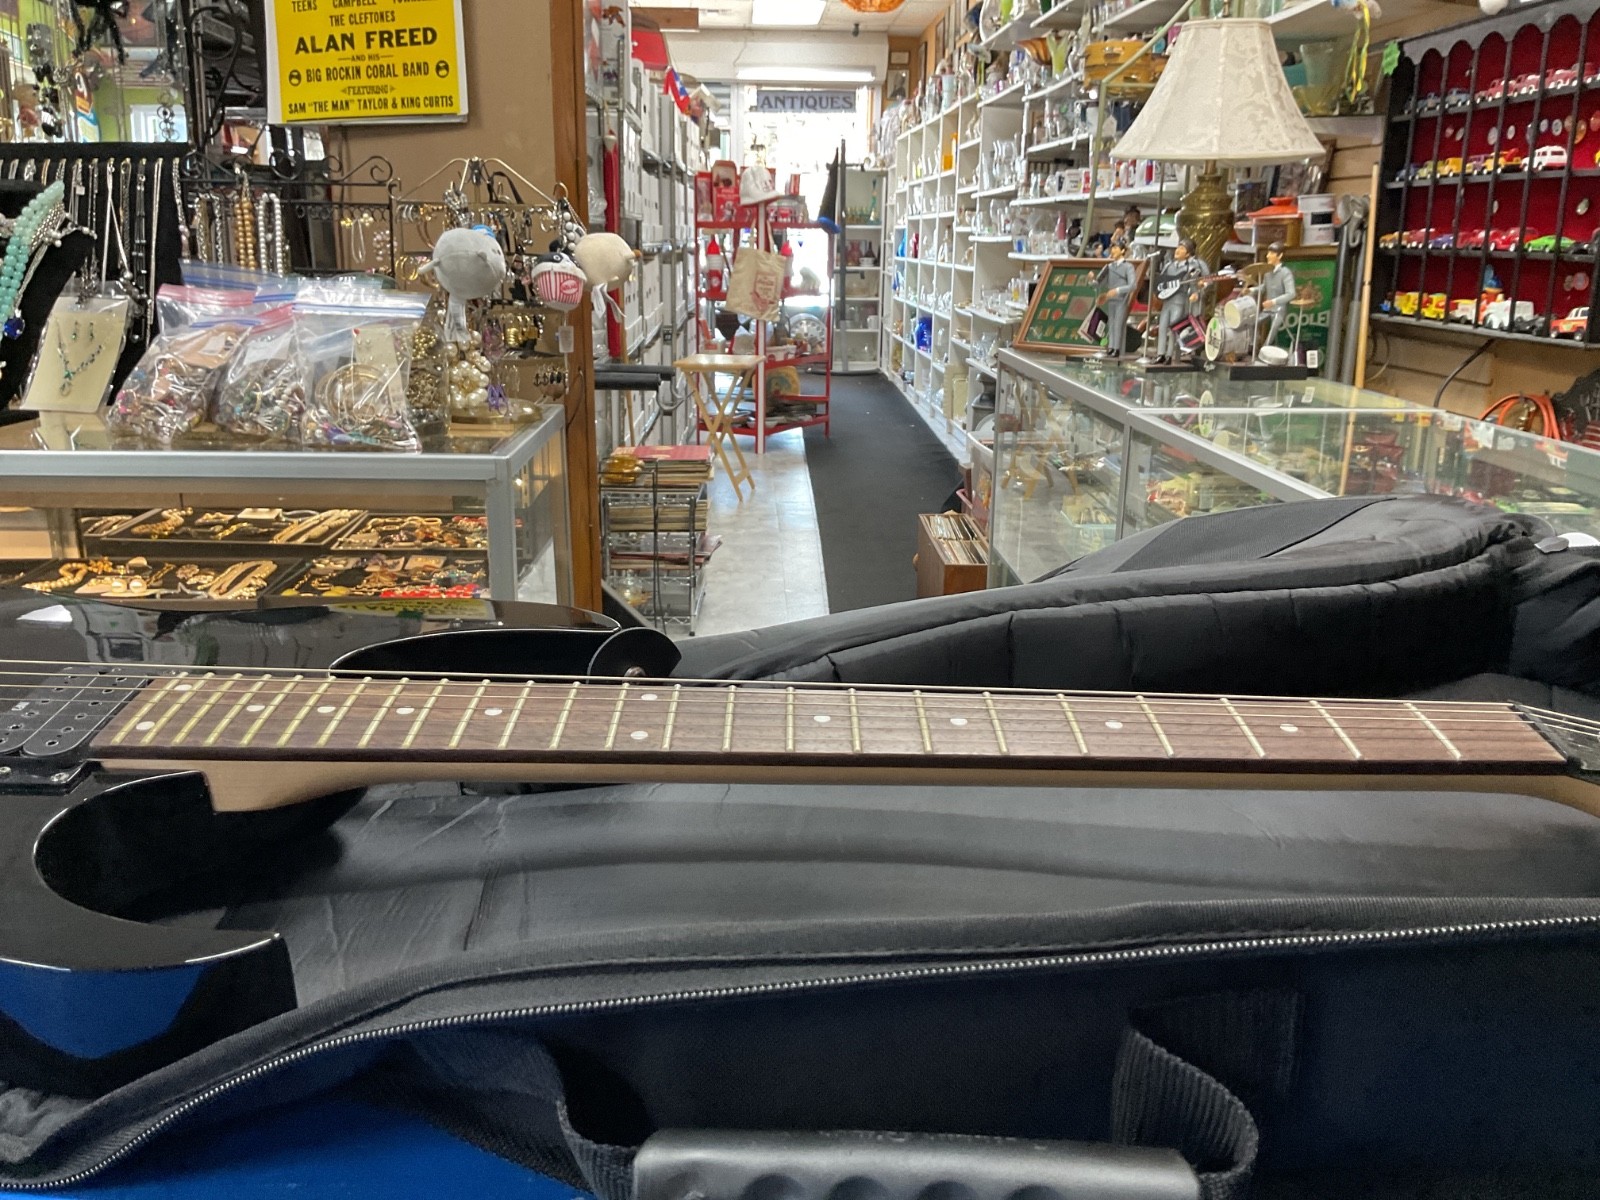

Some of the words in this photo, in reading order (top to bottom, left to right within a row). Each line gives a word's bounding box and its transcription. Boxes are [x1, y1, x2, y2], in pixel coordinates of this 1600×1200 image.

[292, 0, 318, 12] TEENS
[329, 15, 346, 27] THE
[349, 10, 396, 25] CLEFTONES
[295, 32, 356, 55] ALAN
[365, 26, 438, 50] FREED
[351, 54, 366, 62] AND
[368, 54, 381, 62] HIS
[306, 68, 322, 83] BIG
[326, 65, 362, 82] ROCKIN
[366, 63, 399, 79] CORAL
[403, 62, 430, 76] BAND
[347, 85, 389, 96] FEATURING
[288, 102, 307, 114] SAM
[358, 98, 389, 111] TAYLOR
[391, 97, 398, 109] &
[401, 97, 421, 109] KING
[424, 95, 454, 108] CURTIS
[760, 95, 853, 110] ANTIQUES
[1278, 310, 1331, 331] OOLE
